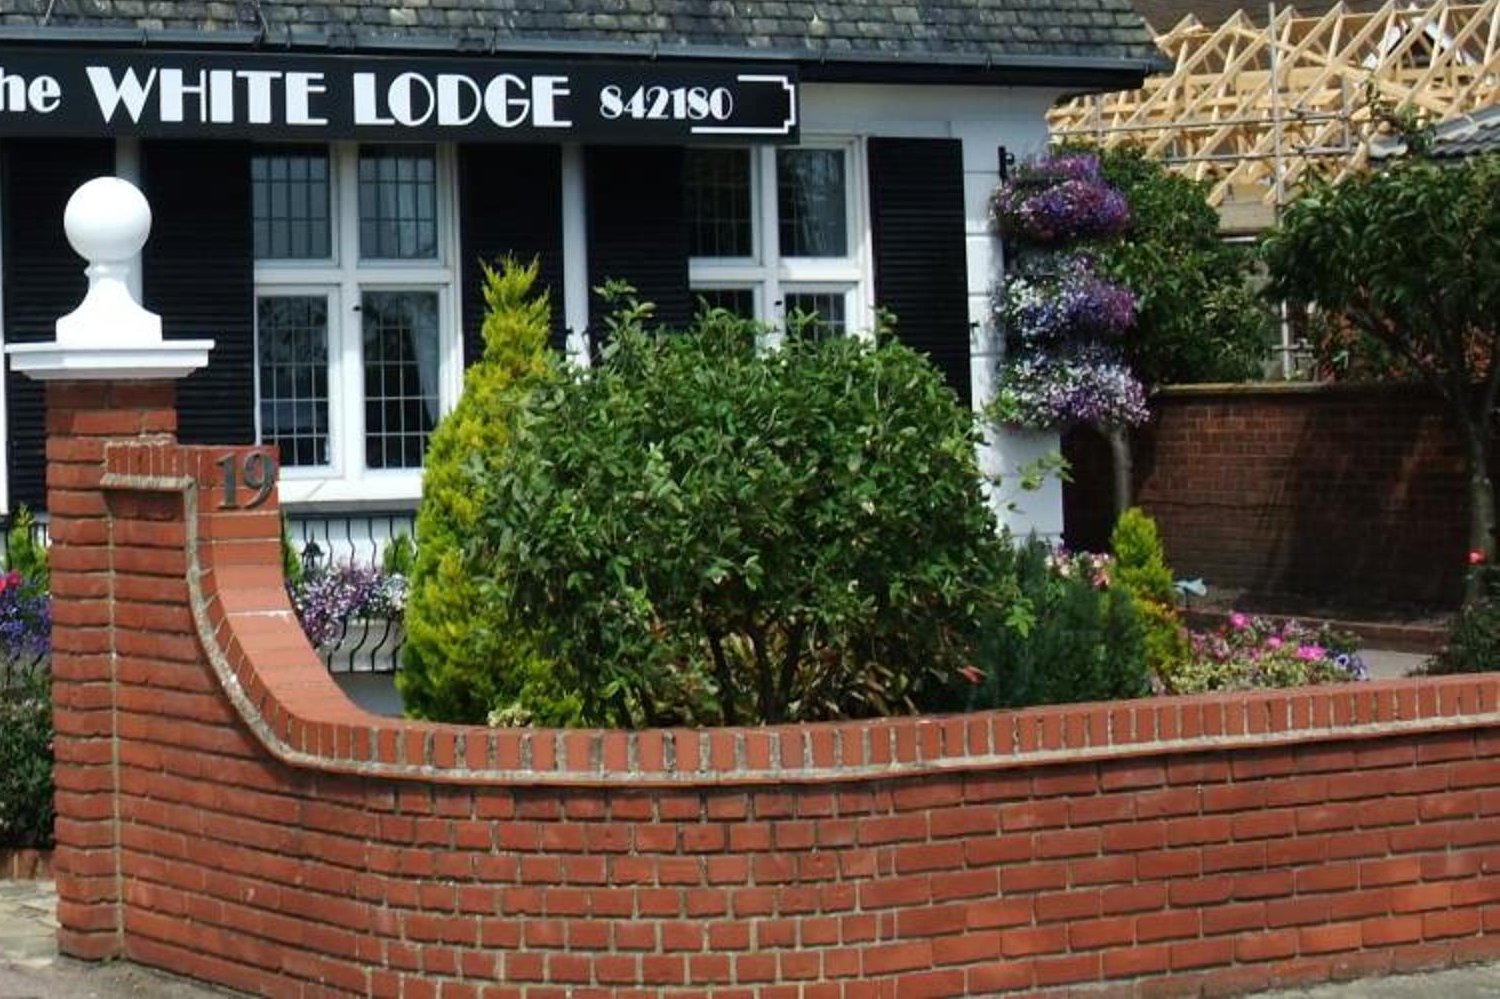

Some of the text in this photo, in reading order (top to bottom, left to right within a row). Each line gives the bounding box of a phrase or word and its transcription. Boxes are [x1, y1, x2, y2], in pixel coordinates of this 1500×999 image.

[85, 66, 329, 125] WHITE
[353, 71, 573, 128] LODGE
[599, 84, 734, 120] 842180
[215, 451, 276, 510] 19
